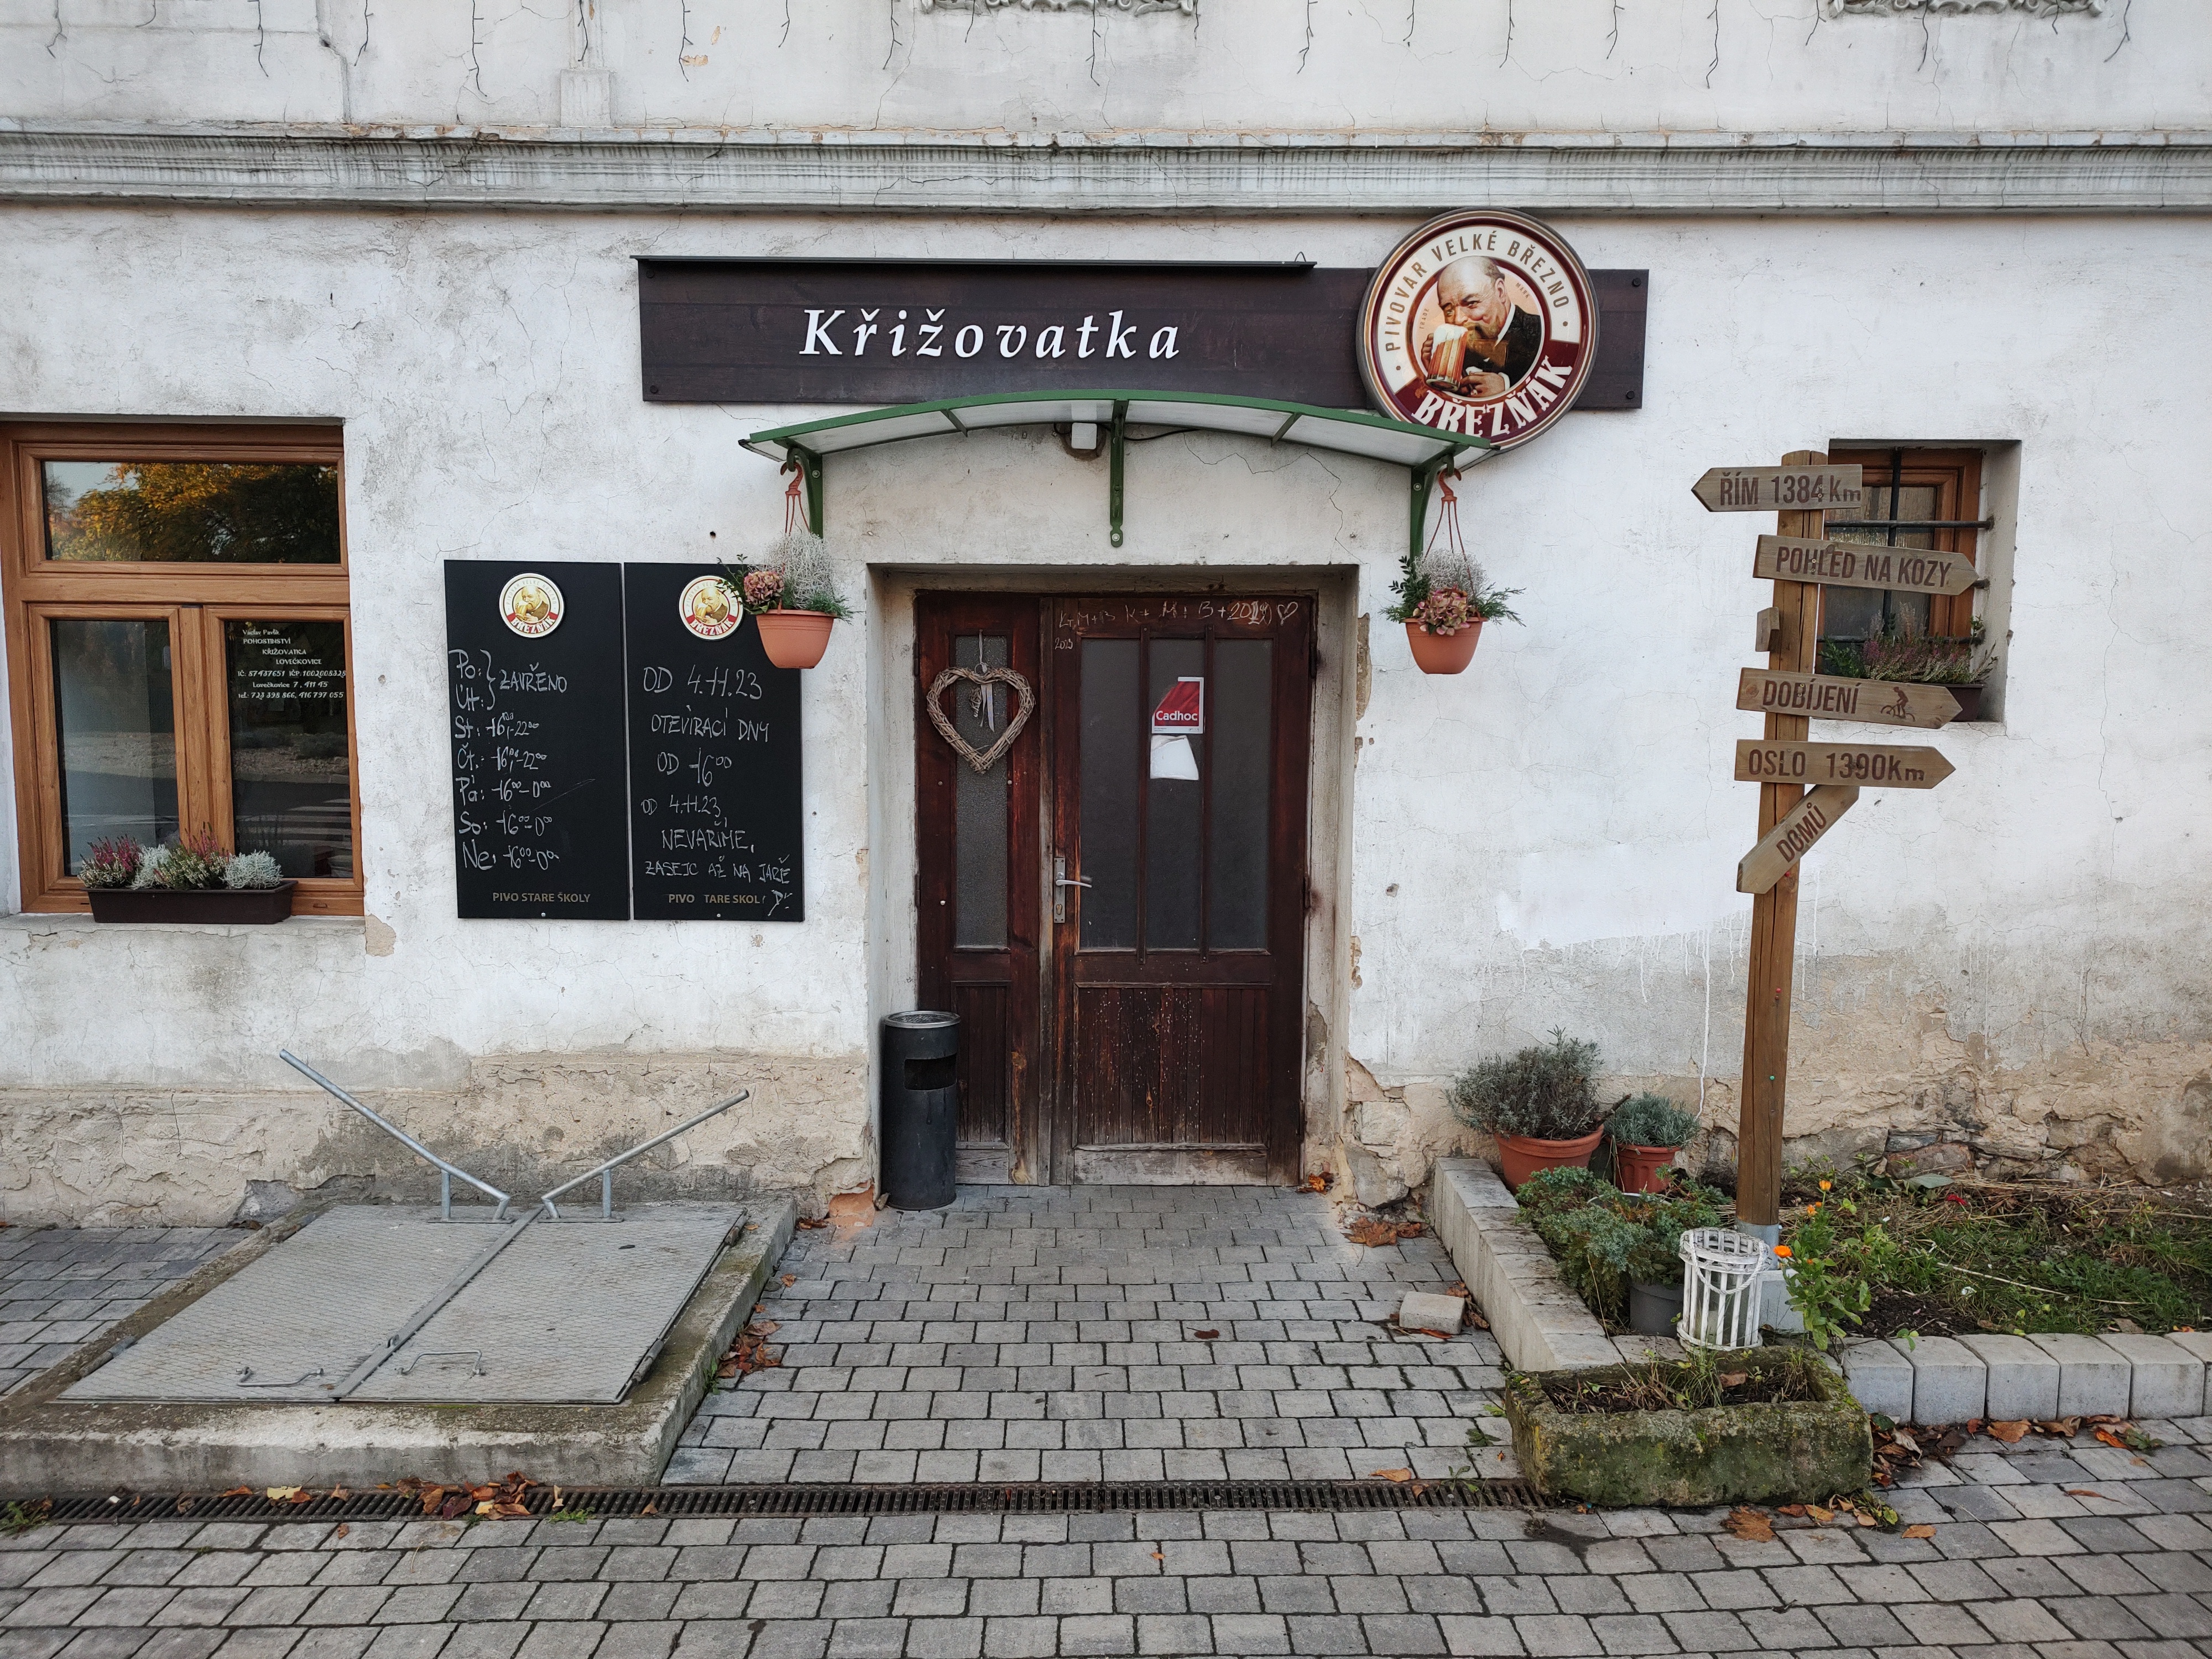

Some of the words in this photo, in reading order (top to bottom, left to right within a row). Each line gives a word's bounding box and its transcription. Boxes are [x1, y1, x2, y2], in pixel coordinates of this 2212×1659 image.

[1385, 261, 1428, 352] PIVOVAR
[1431, 230, 1498, 262] VELKÉ
[1507, 240, 1569, 308] BŘEZNO
[1515, 282, 1532, 299] MARK
[799, 308, 1180, 358] Křižovatka
[1419, 308, 1430, 330] TRADE
[1412, 356, 1573, 437] BŘEZŇÁK
[1720, 471, 1759, 506] ŘÍM
[1771, 474, 1823, 503] 1384
[1776, 546, 1856, 578] POHLED
[1864, 555, 1891, 582] NA
[1898, 557, 1952, 588] KOZY
[499, 662, 567, 693] ZAVŘENO
[643, 666, 673, 693] OD
[1762, 678, 1861, 714] DOBÍJENÍ
[651, 705, 728, 738] OTEVÍRACÍ
[738, 719, 769, 743] DNY
[1156, 710, 1198, 721] Cadhoc
[657, 752, 680, 775] OD
[1749, 749, 1806, 777] OSLO
[641, 798, 658, 815] OD
[1776, 802, 1827, 863] DOMŮ
[708, 855, 726, 878] AŽ
[733, 863, 751, 883] NA
[493, 893, 519, 902] PIVO
[521, 893, 555, 902] STARE
[669, 894, 695, 903] PIVO
